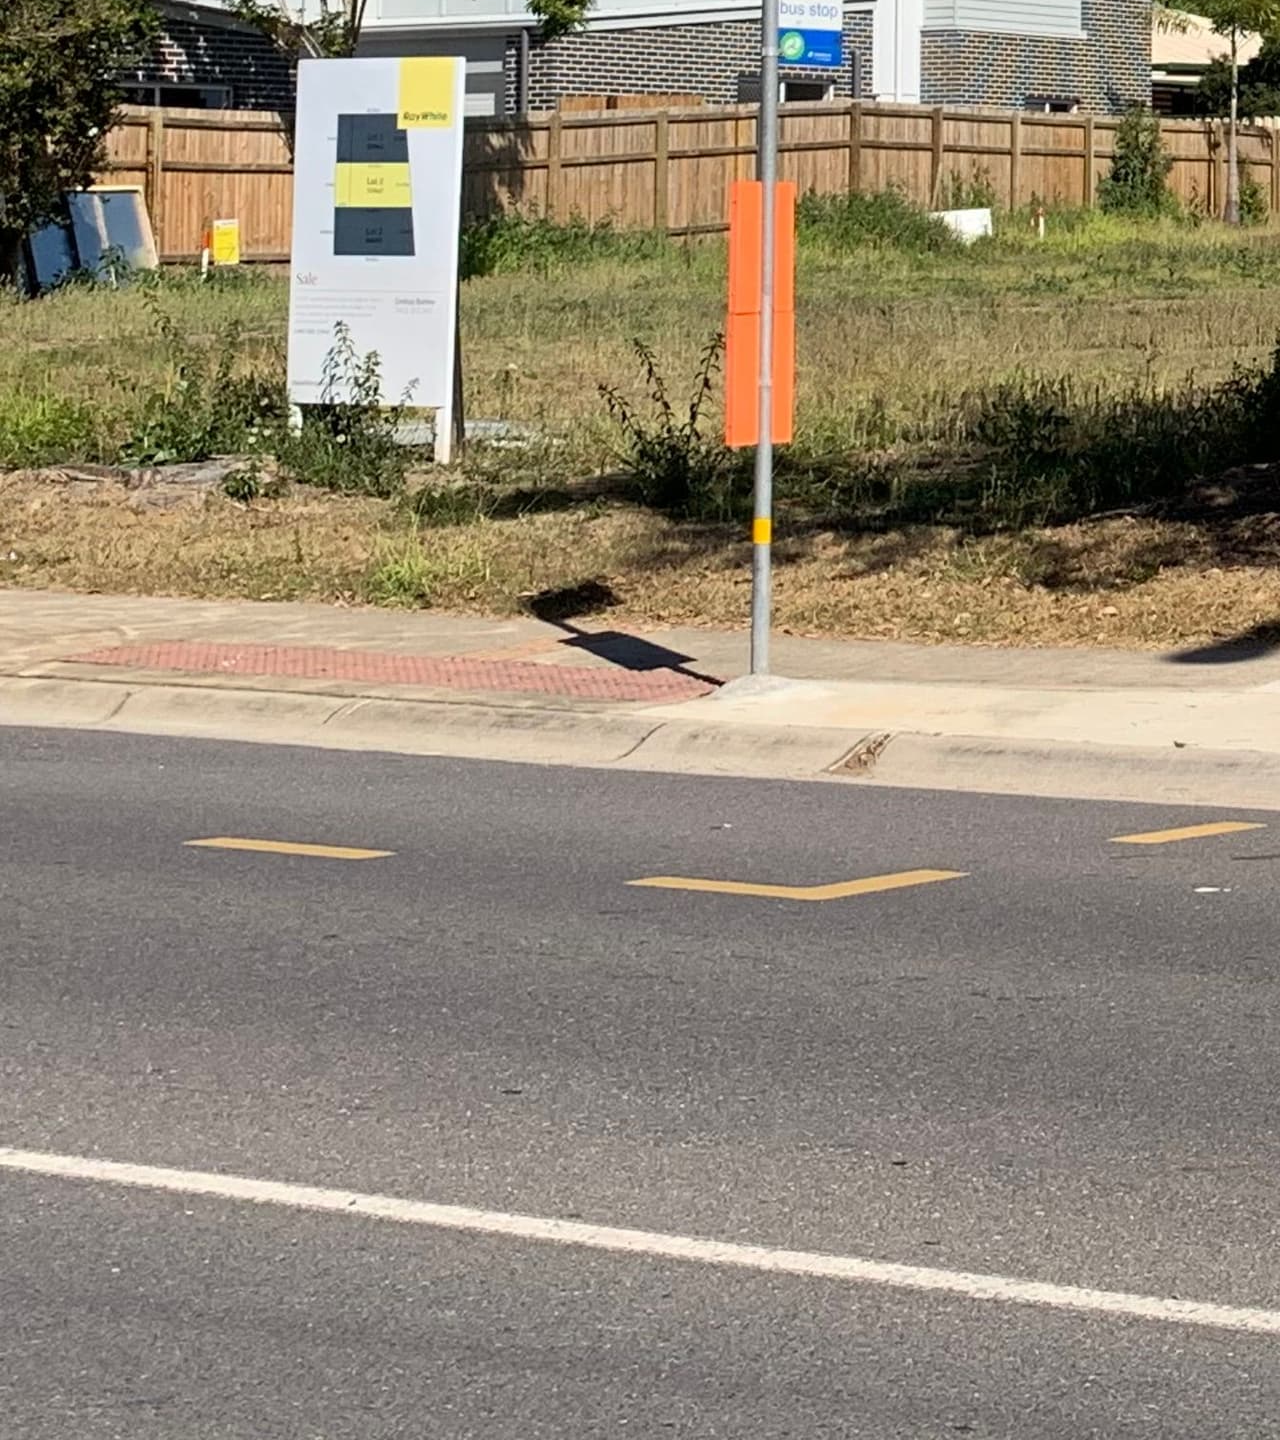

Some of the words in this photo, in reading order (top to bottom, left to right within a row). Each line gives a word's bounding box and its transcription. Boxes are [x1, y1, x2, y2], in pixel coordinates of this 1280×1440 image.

[780, 0, 805, 16] bus
[809, 3, 839, 20] stop
[296, 271, 319, 286] Sale
